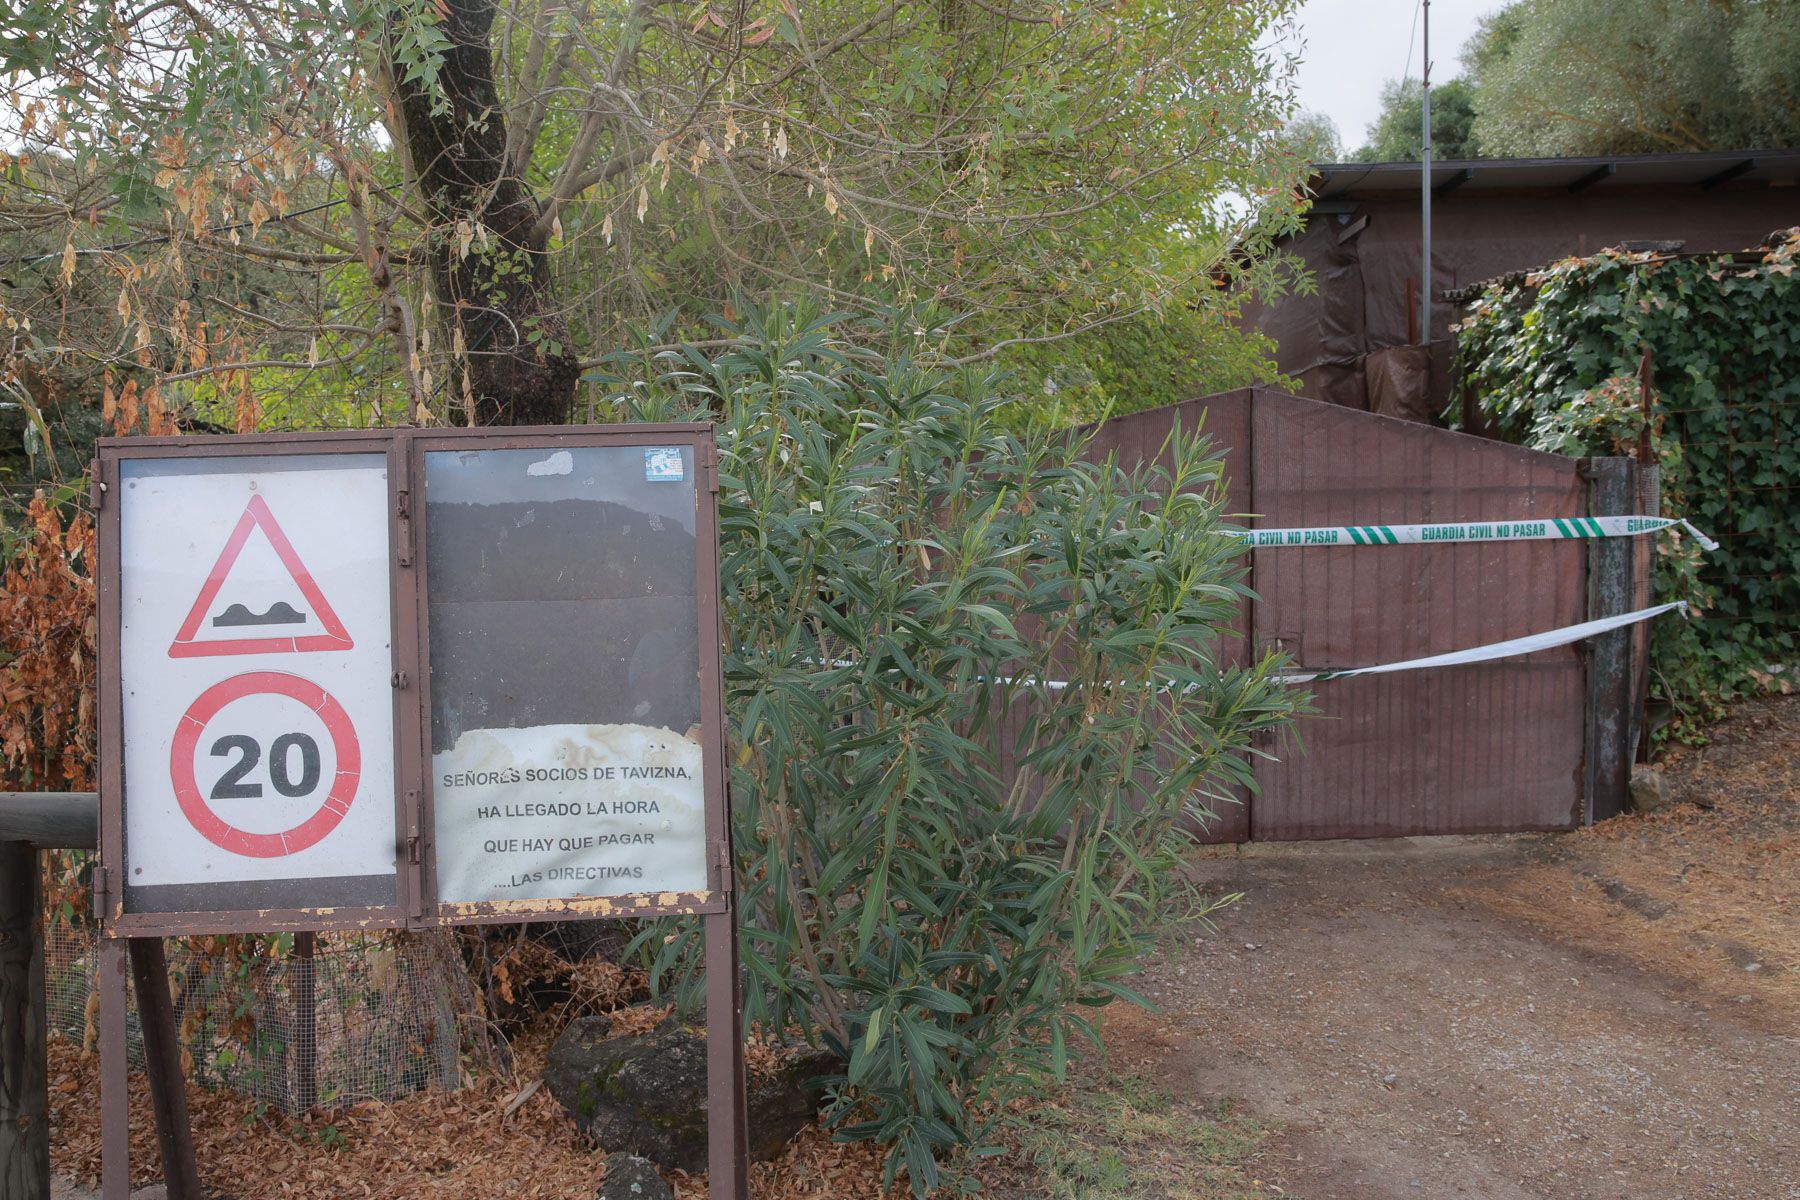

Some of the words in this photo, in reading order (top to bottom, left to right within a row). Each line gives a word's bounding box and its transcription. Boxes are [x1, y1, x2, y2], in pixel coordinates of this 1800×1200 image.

[1259, 532, 1284, 545] CIVIL
[1287, 531, 1302, 545] NO
[1304, 530, 1339, 544] PASAR
[1421, 526, 1466, 541] GUARDIA
[1468, 525, 1493, 539] CIVIL
[1496, 524, 1511, 538] NO
[1513, 522, 1547, 537] PASAR
[209, 732, 321, 800] 20
[525, 768, 589, 782] SOCIOS
[593, 766, 615, 781] DE
[620, 766, 692, 781] TAVIZNA,
[477, 805, 502, 819] HA
[505, 802, 582, 818] LLEGADO
[586, 802, 609, 816] LA
[612, 800, 661, 815] HORA
[483, 839, 519, 853] QUE
[522, 838, 555, 853] HAY
[558, 836, 594, 852] QUE
[597, 832, 656, 846] PAGAR
[547, 866, 643, 881] DIRECTIVAS
